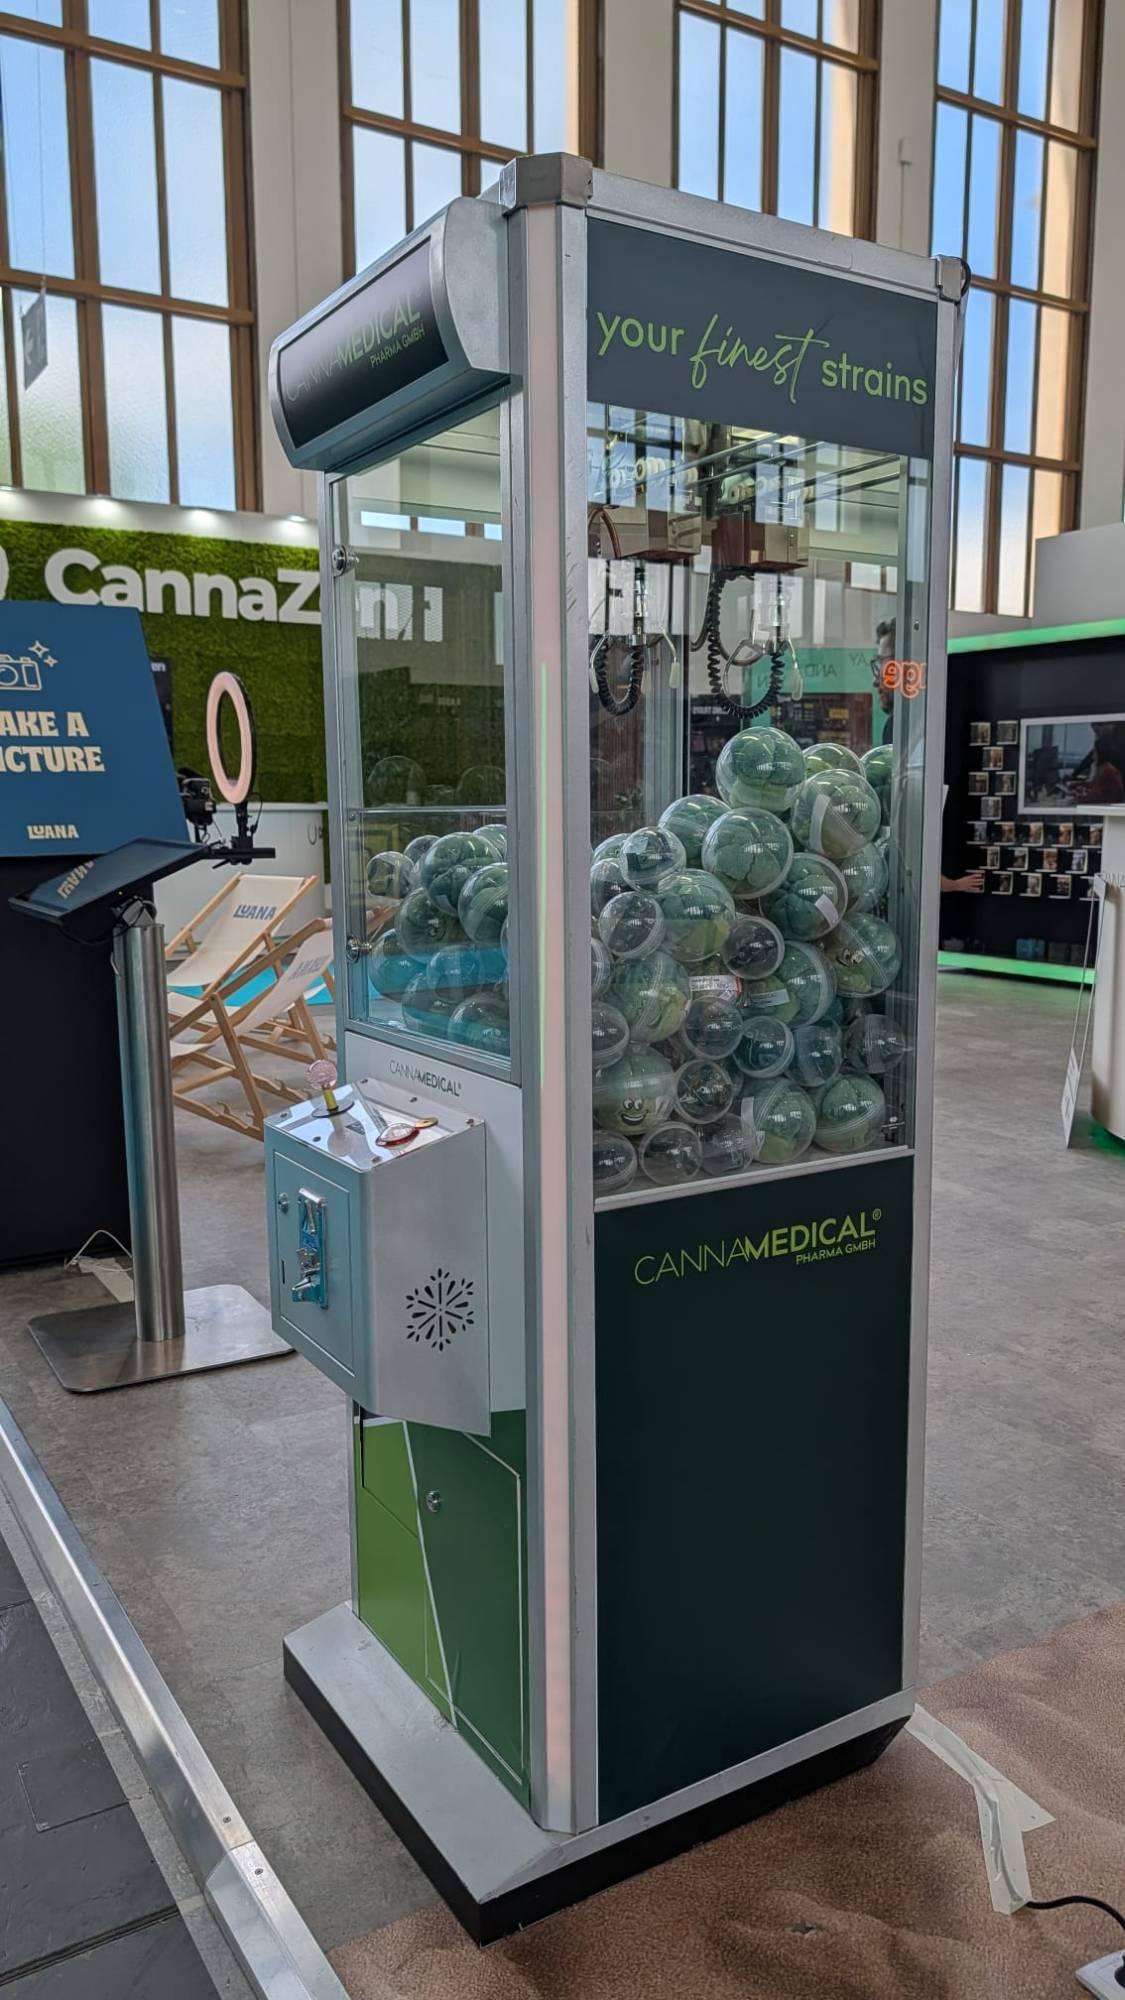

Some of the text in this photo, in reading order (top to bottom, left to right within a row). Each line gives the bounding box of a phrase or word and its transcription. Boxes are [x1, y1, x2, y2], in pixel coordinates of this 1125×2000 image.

[369, 340, 402, 368] PHARMA
[597, 311, 928, 405] your finest strains
[0, 710, 90, 737] AKE A
[0, 745, 105, 773] CTURE
[27, 824, 80, 840] LUANA
[232, 904, 278, 921] LUANA
[795, 1238, 876, 1265] PHARMA GMBH
